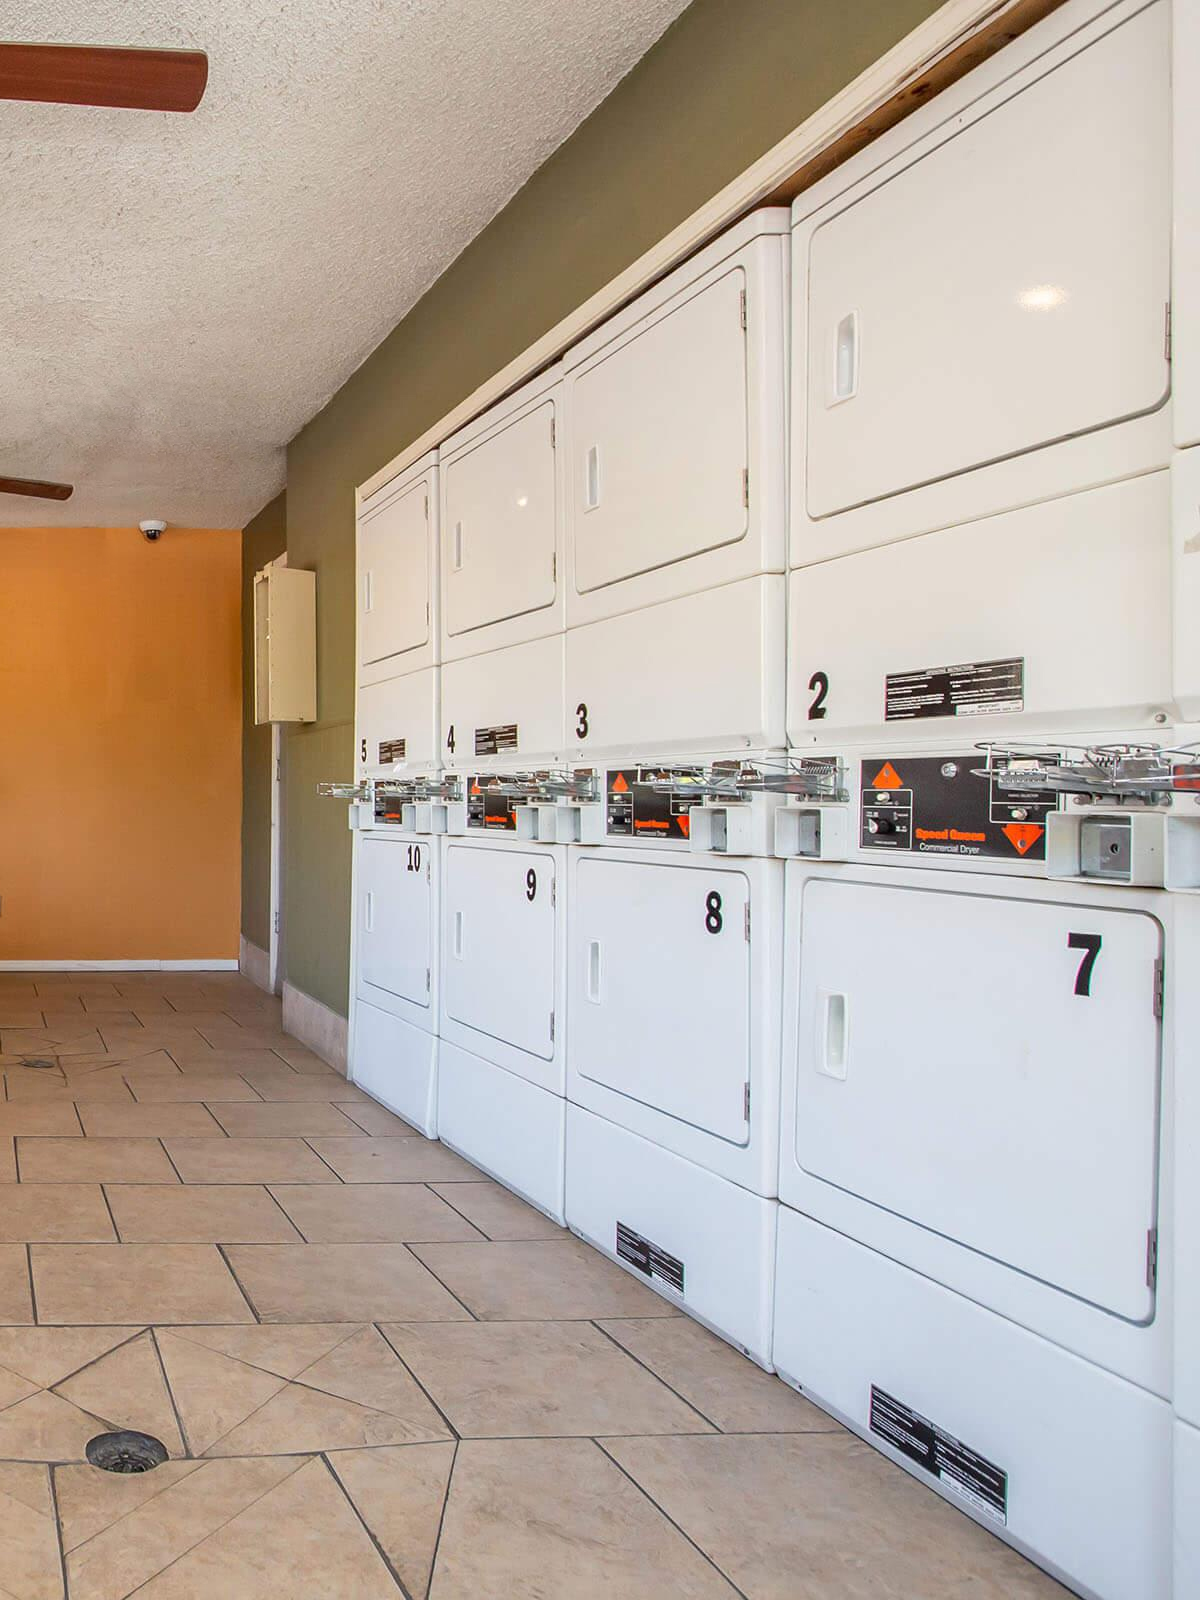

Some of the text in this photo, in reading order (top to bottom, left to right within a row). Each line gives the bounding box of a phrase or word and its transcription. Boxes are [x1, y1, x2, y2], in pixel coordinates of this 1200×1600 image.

[809, 672, 828, 720] 2
[575, 703, 590, 739] 3
[361, 738, 368, 763] 5
[446, 725, 456, 754] 4
[407, 844, 422, 873] 10
[919, 842, 980, 855] Commercial Dryer
[526, 868, 537, 902] 9
[706, 891, 722, 934] 8
[1068, 933, 1101, 996] 7
